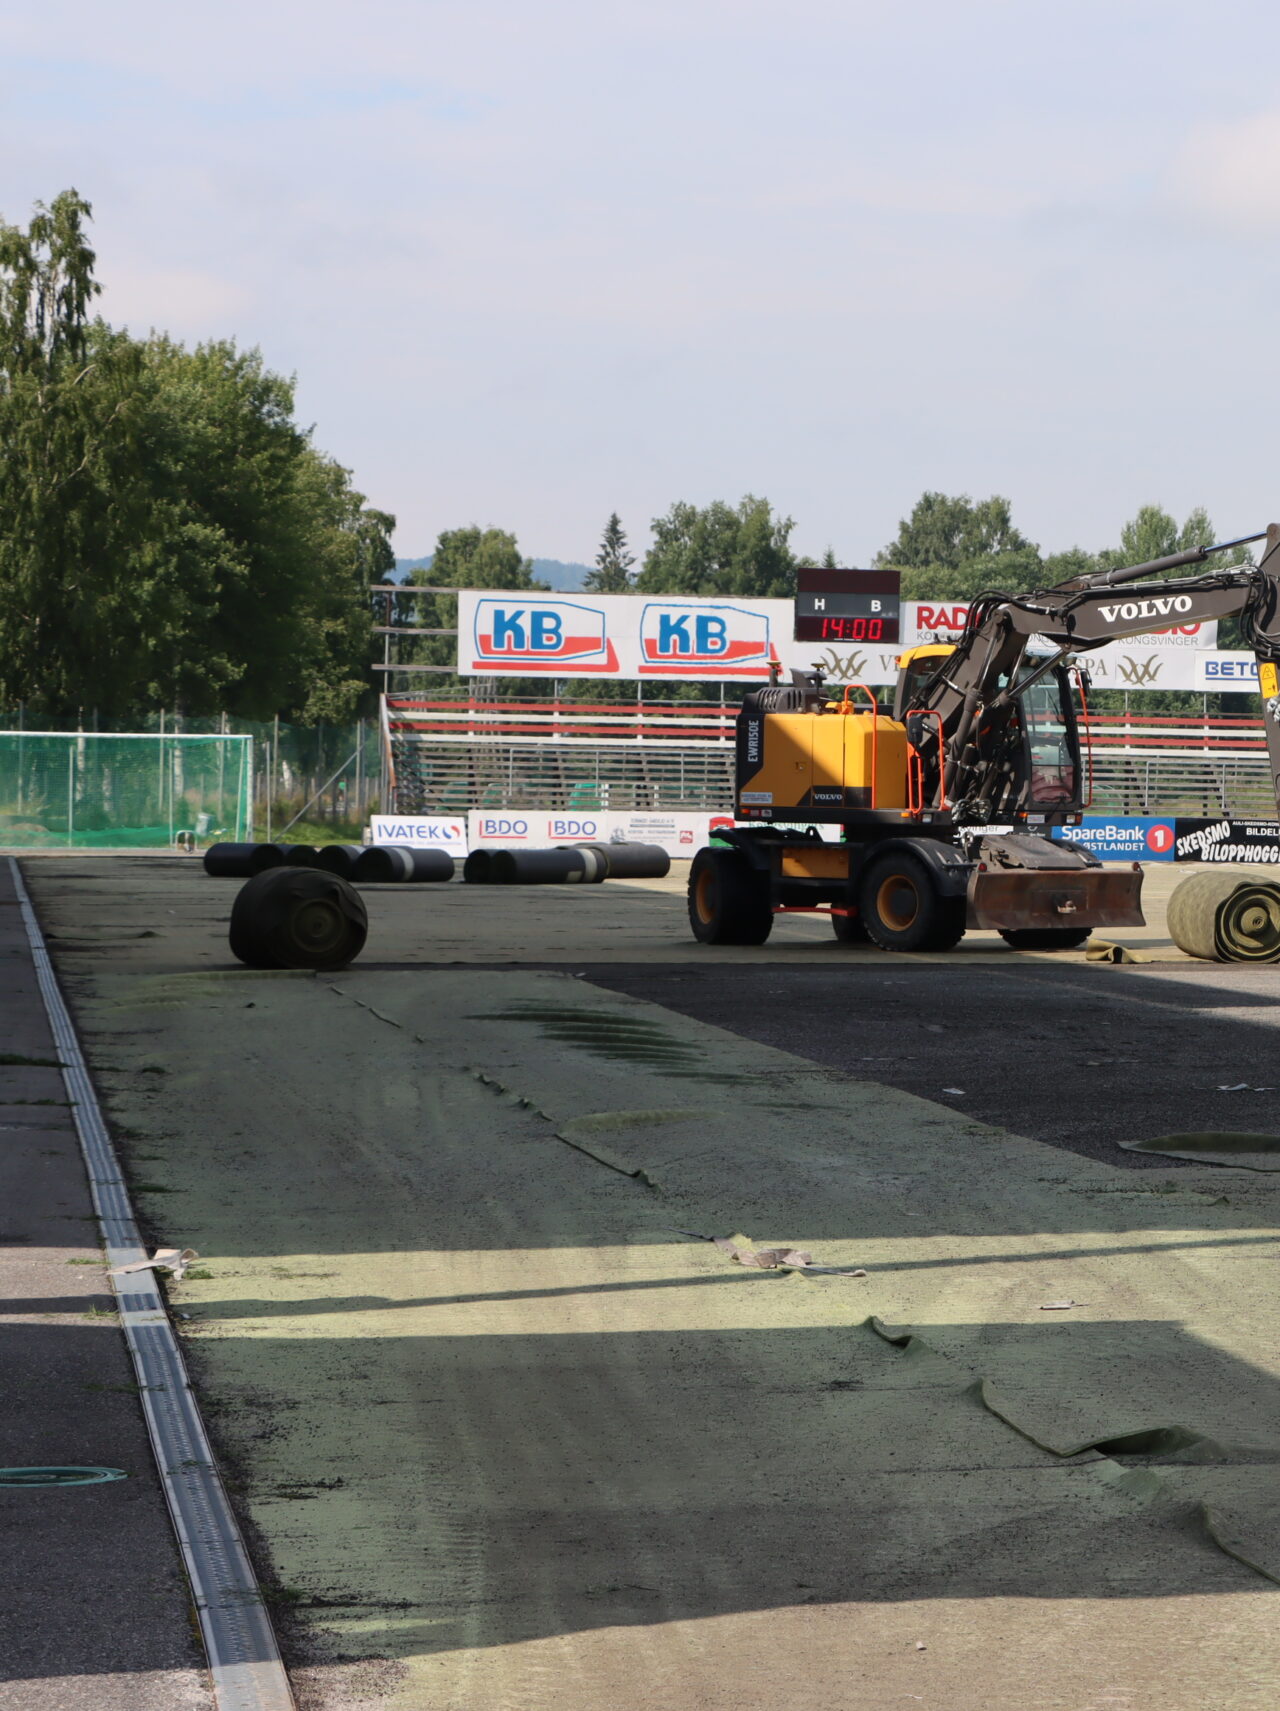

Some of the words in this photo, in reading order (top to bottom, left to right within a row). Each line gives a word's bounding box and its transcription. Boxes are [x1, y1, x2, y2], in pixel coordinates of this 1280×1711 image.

[814, 598, 826, 611] H
[871, 599, 882, 612] B
[1098, 595, 1192, 622] VOLVO
[493, 609, 562, 650] KB
[659, 614, 727, 655] KB
[822, 618, 883, 640] 14:00
[1118, 635, 1200, 647] KONGSVINGER
[1205, 661, 1259, 677] BETO
[747, 720, 759, 762] EWR150E
[814, 793, 843, 801] VOLVO
[378, 824, 441, 839] IVATEK
[485, 819, 528, 835] BDO
[554, 820, 597, 836] BDO
[1062, 825, 1144, 842] SpareBank
[1154, 830, 1164, 847] 1
[1176, 820, 1231, 857] SKEDSMO
